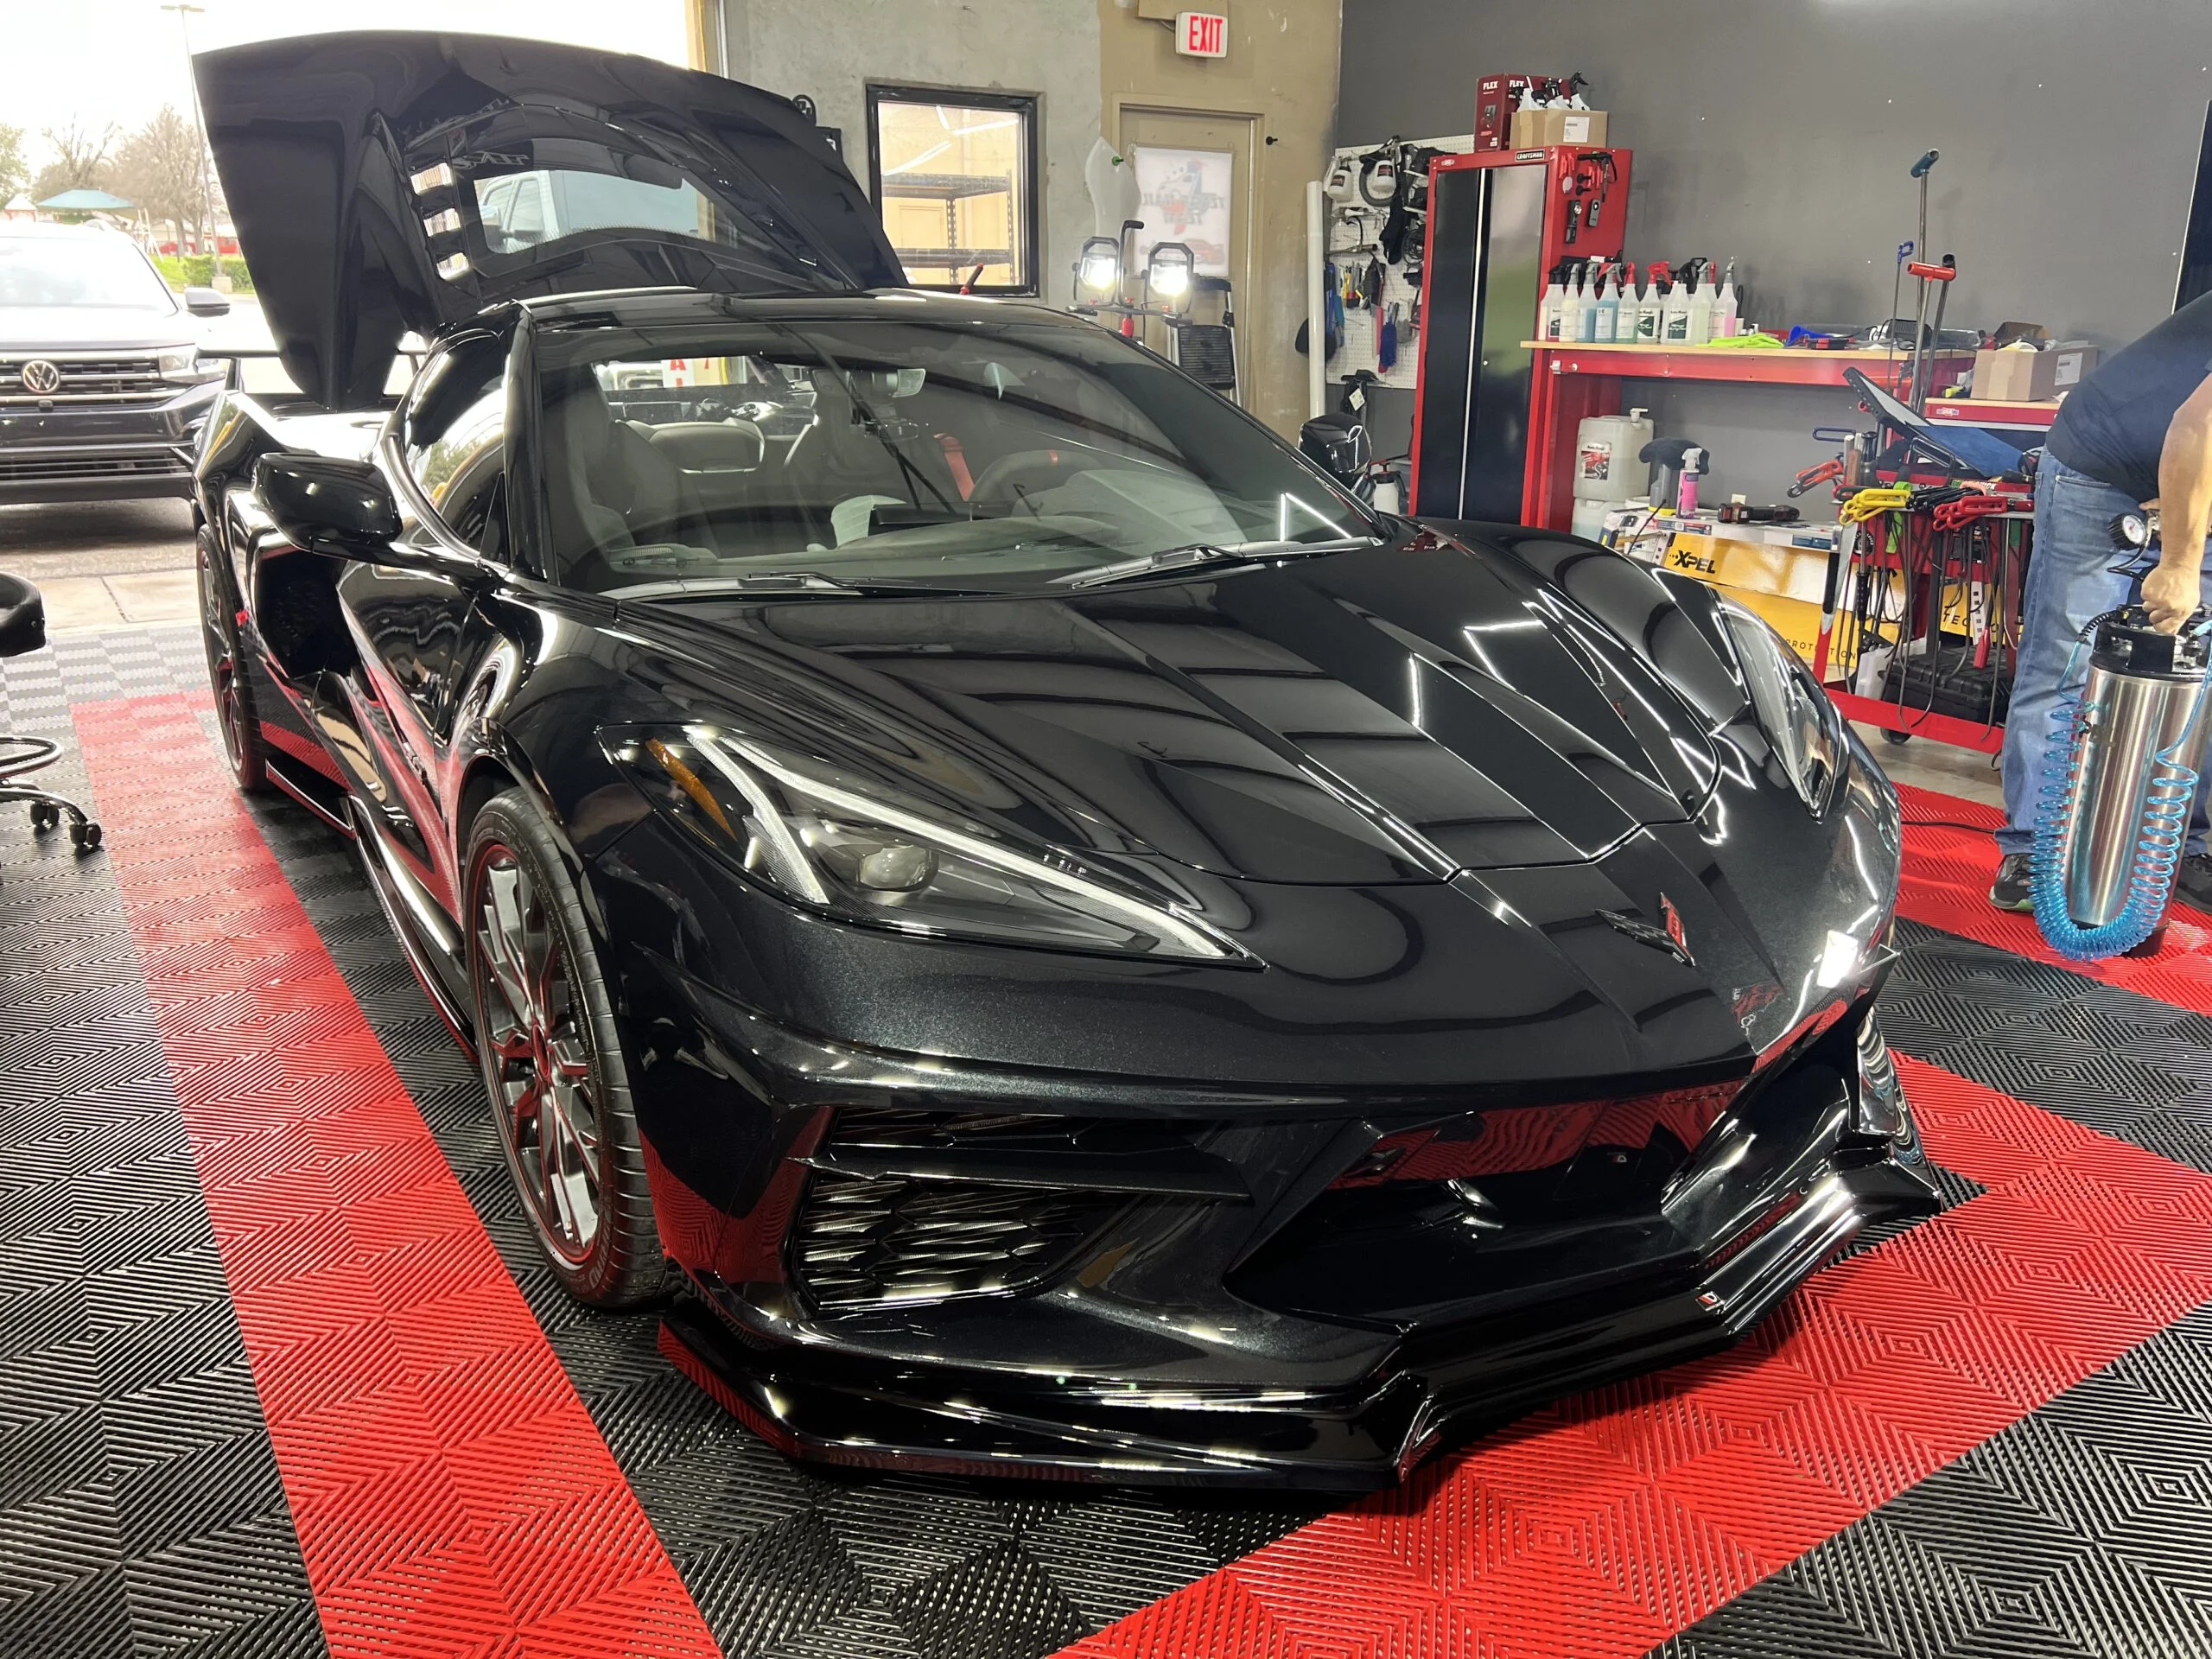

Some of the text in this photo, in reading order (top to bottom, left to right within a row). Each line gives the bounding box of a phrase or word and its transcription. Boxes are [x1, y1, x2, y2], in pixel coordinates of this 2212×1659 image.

[1189, 15, 1224, 54] EXIT
[1483, 80, 1498, 91] FLEX
[1673, 550, 1716, 574] XPEL
